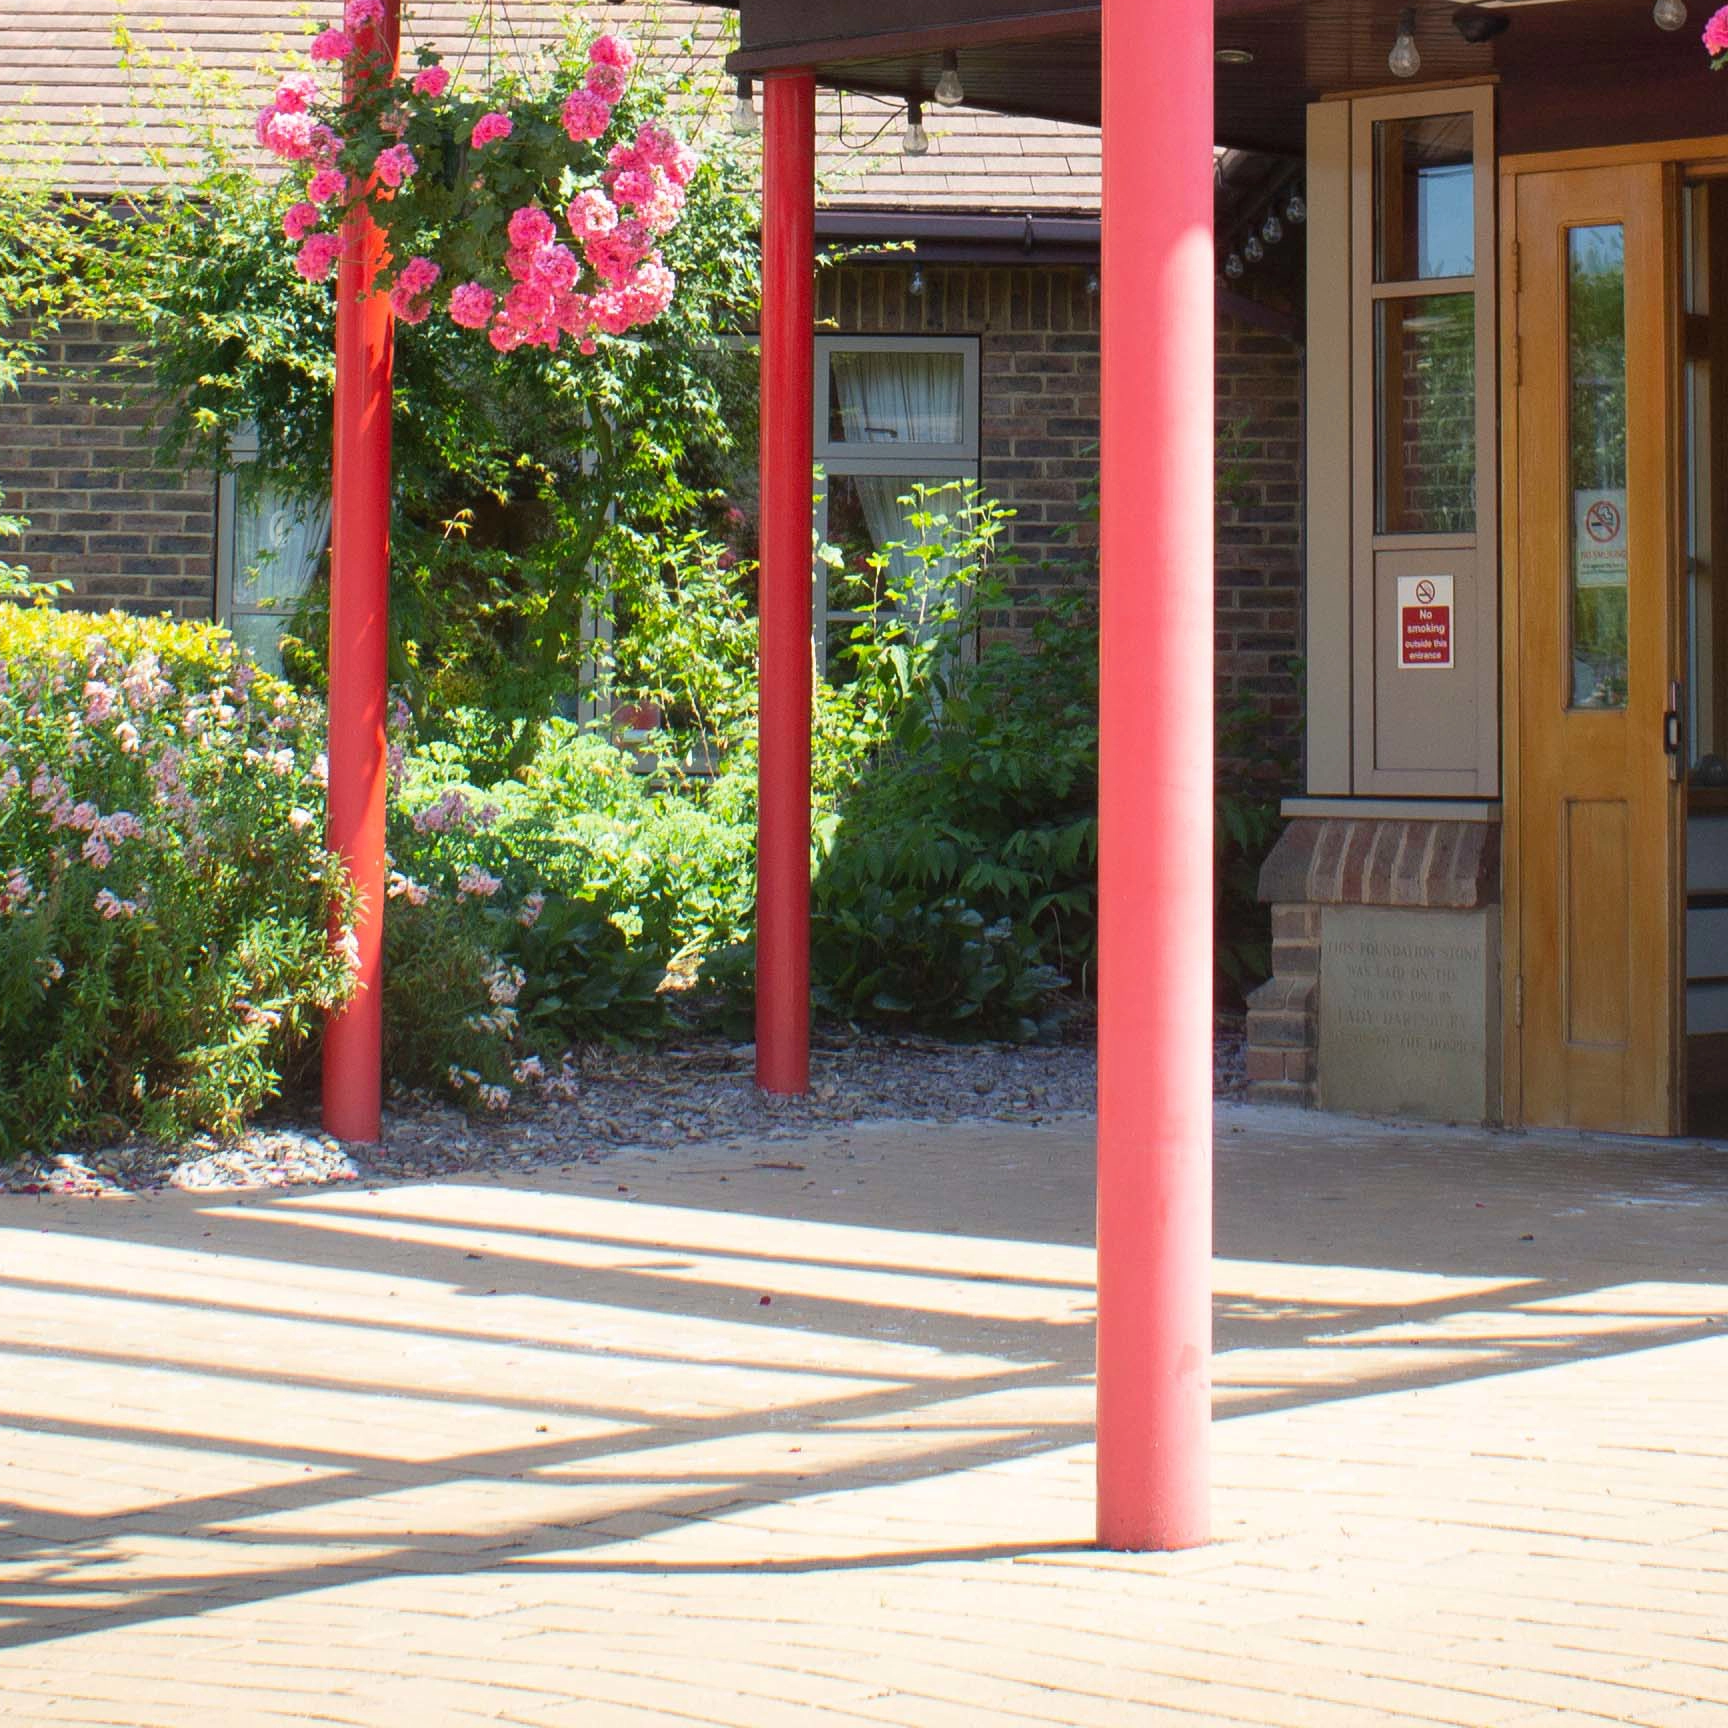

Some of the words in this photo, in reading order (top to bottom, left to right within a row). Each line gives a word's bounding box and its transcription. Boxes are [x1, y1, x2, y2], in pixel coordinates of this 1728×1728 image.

[1419, 608, 1433, 620] No
[1407, 624, 1445, 635] smoking
[1404, 638, 1432, 649] outside
[1433, 638, 1448, 649] this
[1409, 651, 1442, 661] entrance
